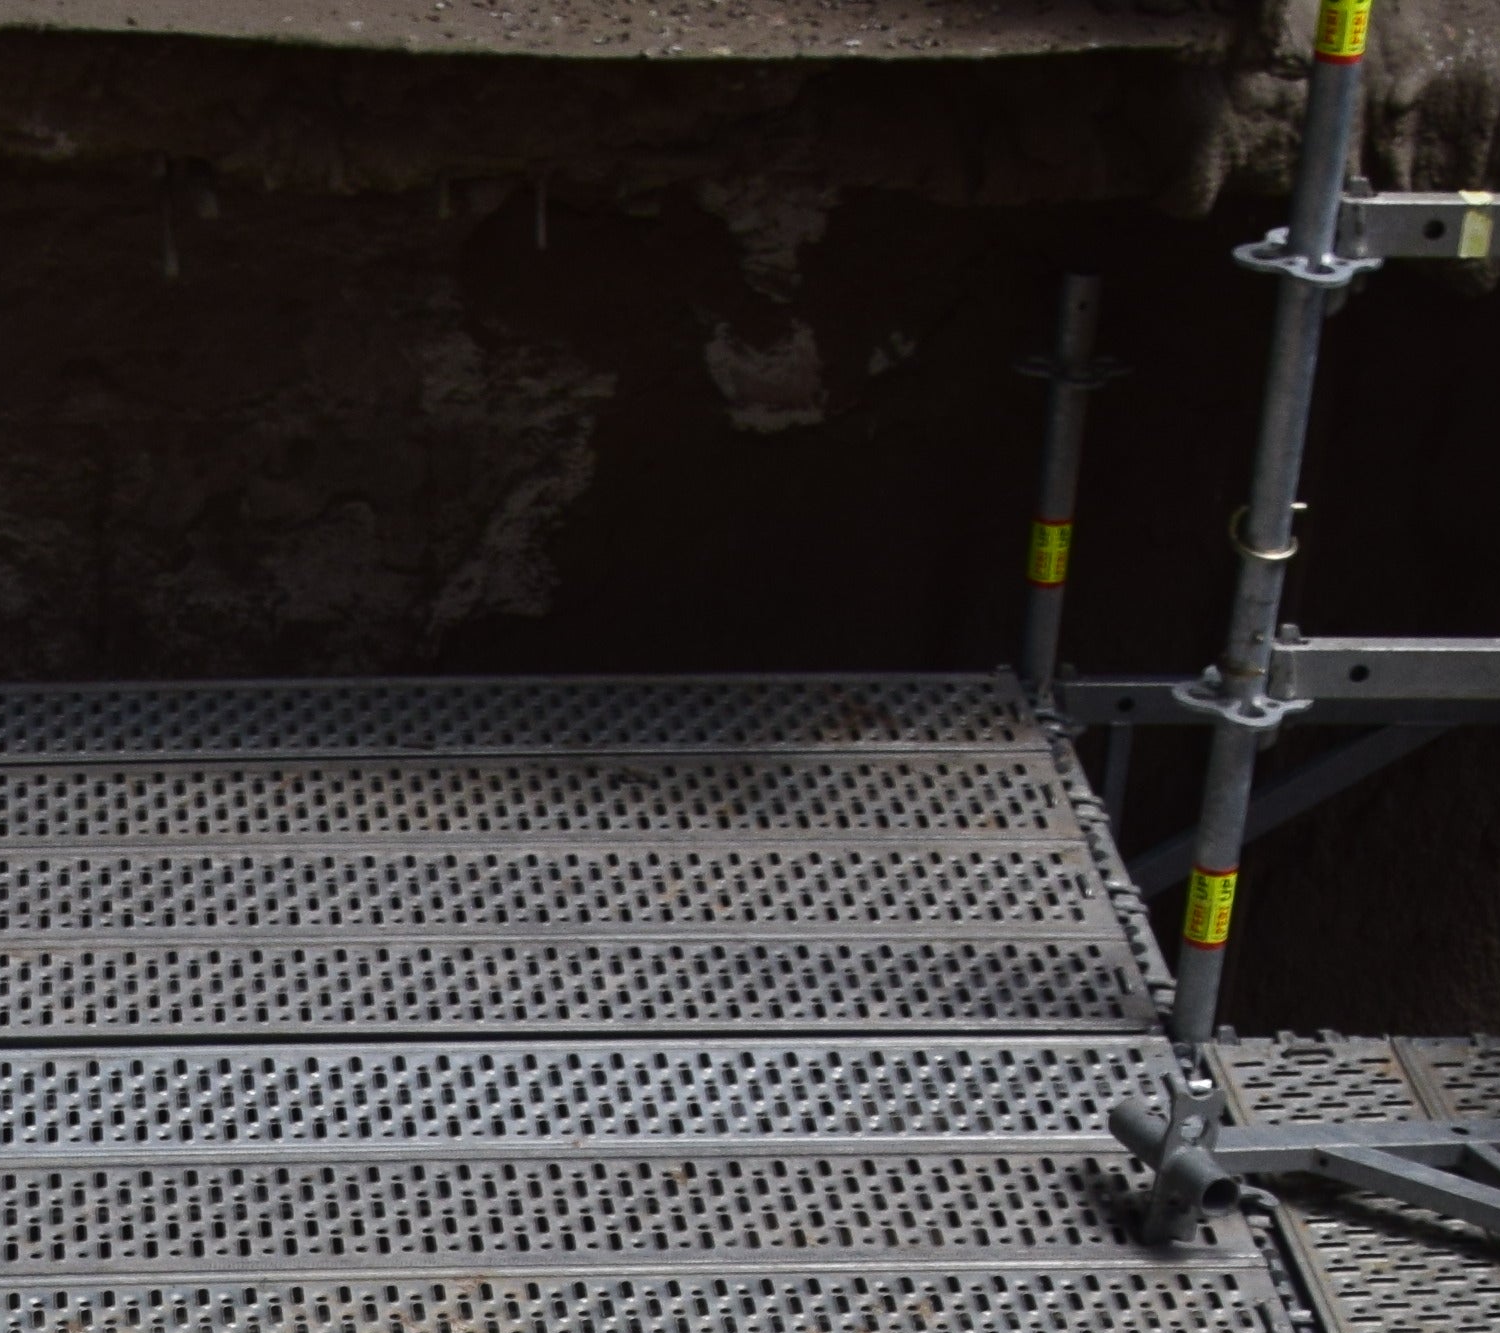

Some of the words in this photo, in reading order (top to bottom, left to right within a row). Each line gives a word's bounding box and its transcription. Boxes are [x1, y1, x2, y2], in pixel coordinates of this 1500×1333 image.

[1350, 9, 1367, 44] PERI
[1195, 875, 1208, 900] UP
[1219, 879, 1232, 901] UP
[1190, 904, 1205, 933] PERI
[1215, 906, 1230, 935] PERI
